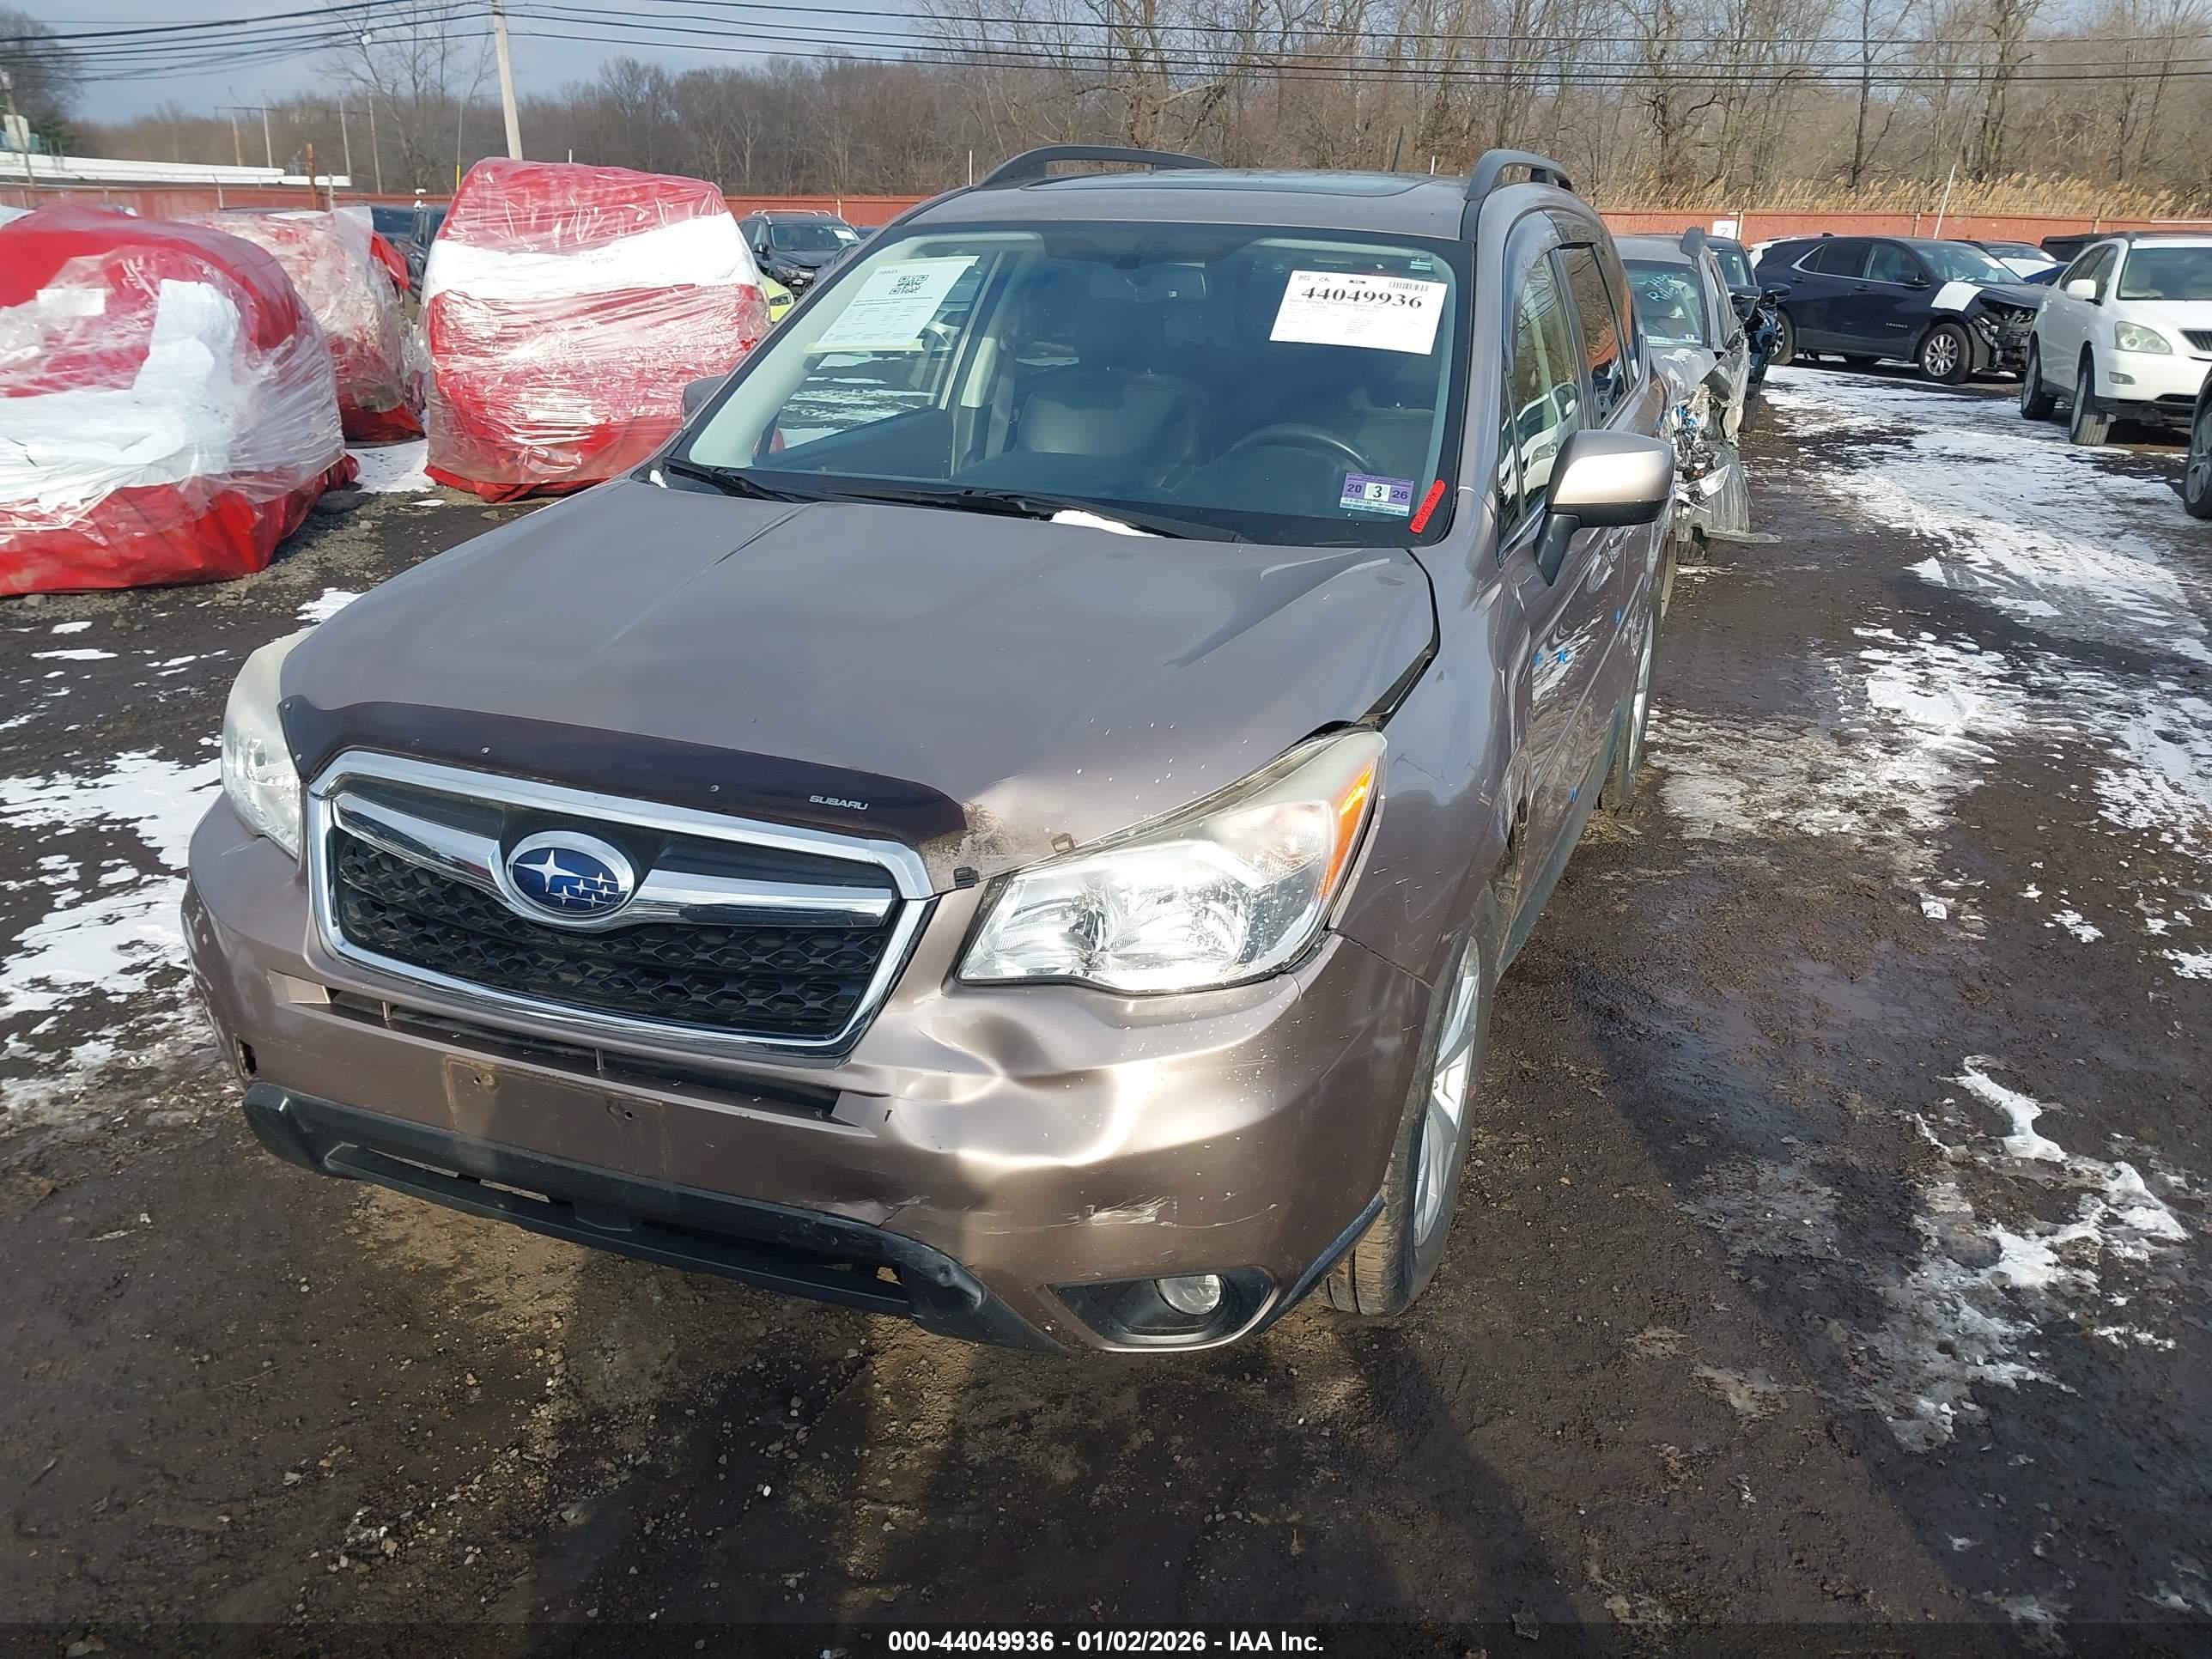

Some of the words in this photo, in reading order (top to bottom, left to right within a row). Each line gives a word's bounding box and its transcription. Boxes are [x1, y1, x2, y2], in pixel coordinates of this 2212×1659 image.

[1301, 286, 1423, 309] 44049936
[1346, 483, 1362, 494] 20
[1372, 485, 1382, 499] 3
[1391, 489, 1408, 500] 26
[809, 795, 868, 811] SUBARU
